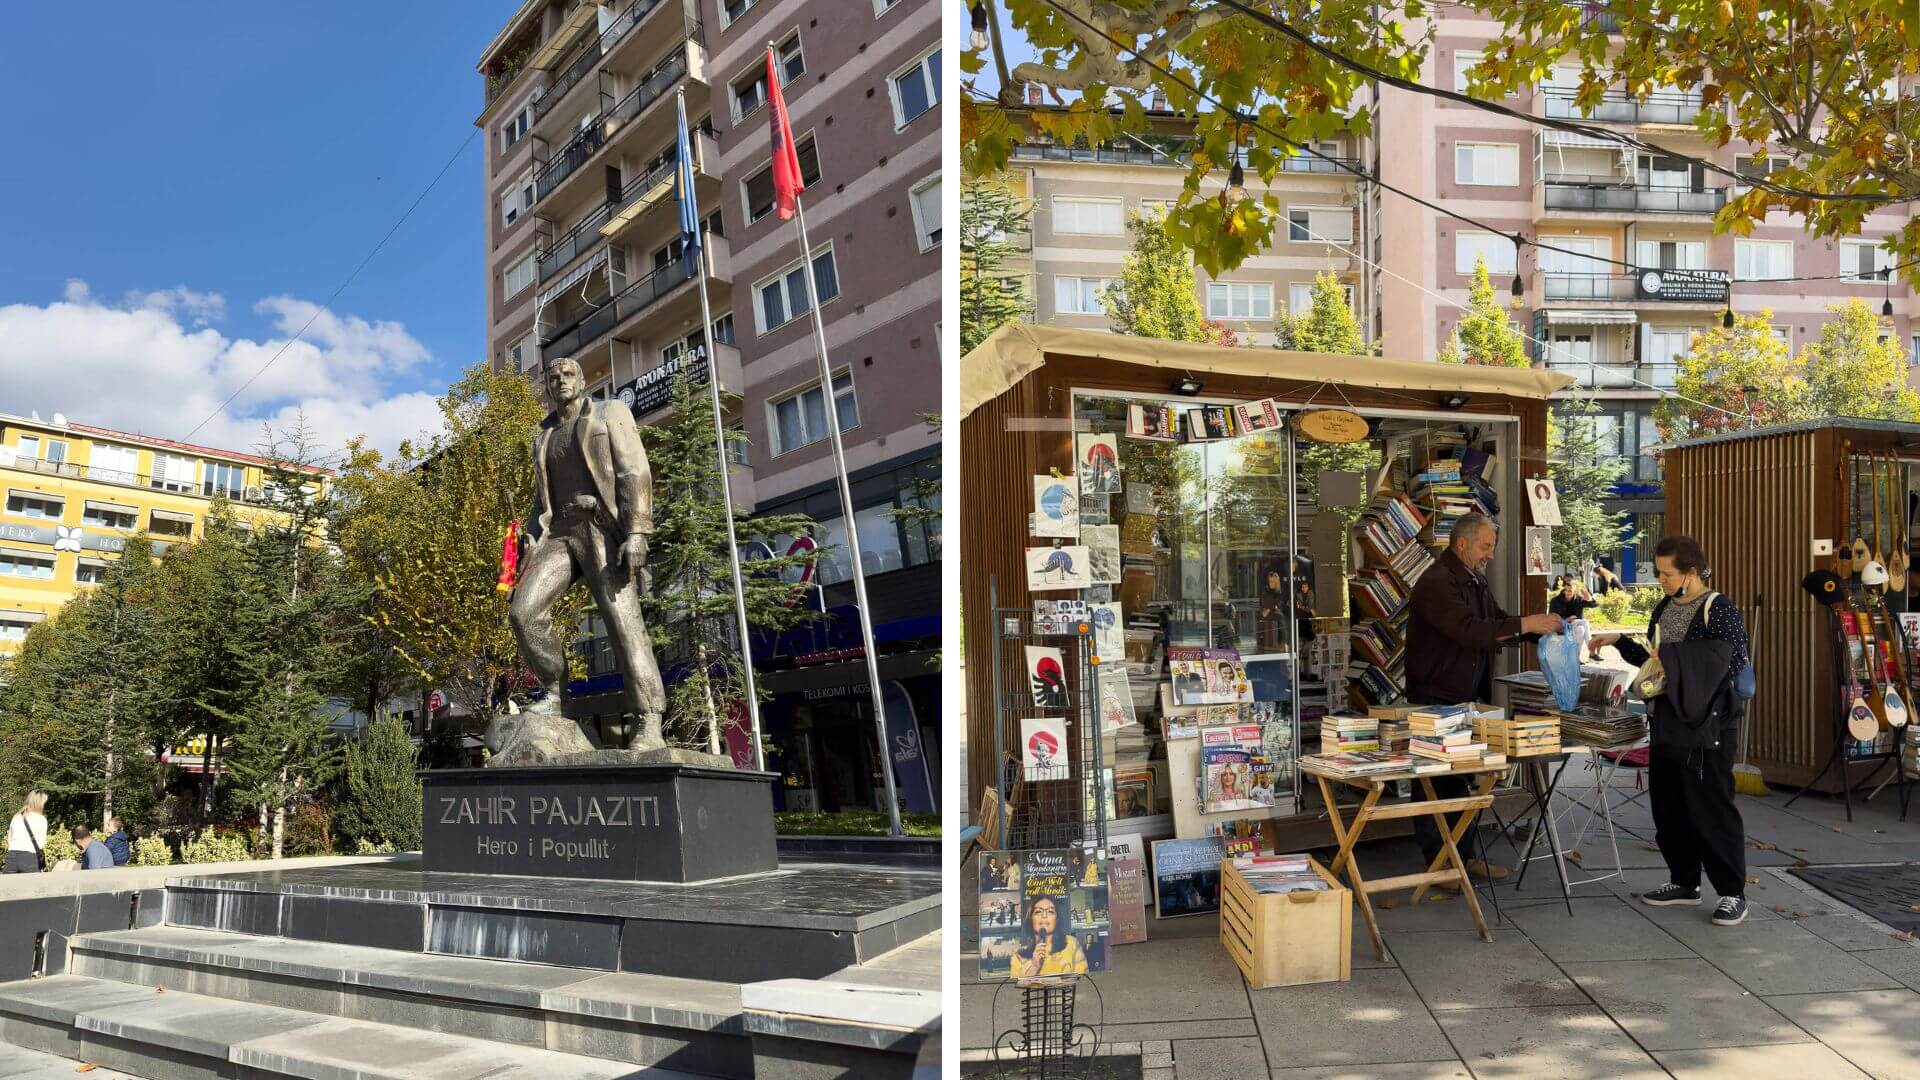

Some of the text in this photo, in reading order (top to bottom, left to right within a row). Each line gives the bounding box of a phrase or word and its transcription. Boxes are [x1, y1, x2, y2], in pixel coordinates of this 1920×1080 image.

[1662, 269, 1726, 282] AVOKATURA
[635, 344, 705, 392] AVOKATRA
[99, 537, 121, 550] HO
[803, 686, 846, 700] TELEKOMI
[853, 684, 871, 695] KOS
[440, 795, 661, 827] ZAHIR PAJAZITI
[476, 835, 610, 861] Hero i Popullit
